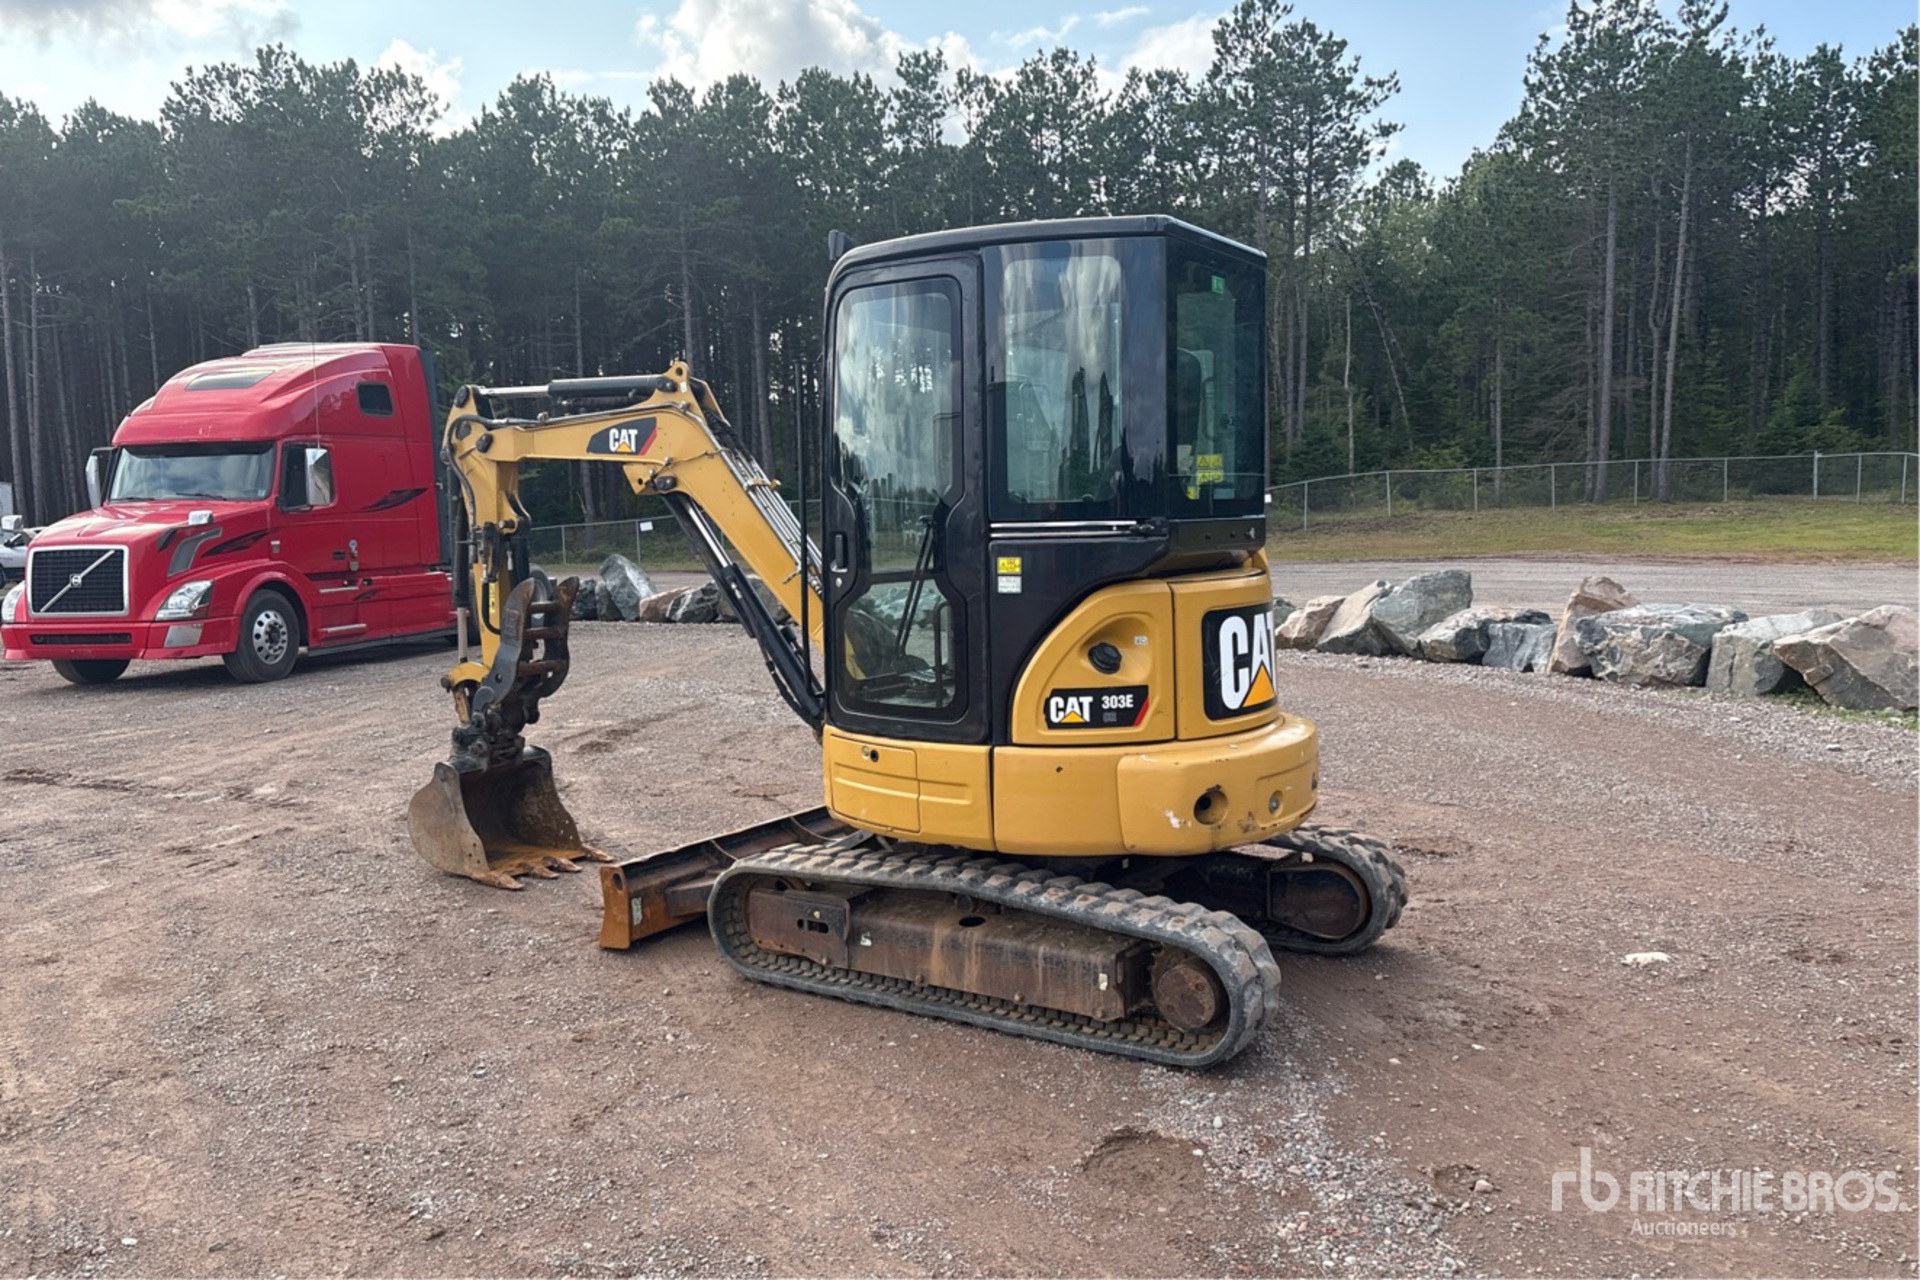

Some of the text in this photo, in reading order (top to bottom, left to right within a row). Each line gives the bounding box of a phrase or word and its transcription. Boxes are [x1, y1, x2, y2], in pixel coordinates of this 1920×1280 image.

[609, 428, 638, 452] CAT
[1050, 694, 1134, 723] CAT 303E
